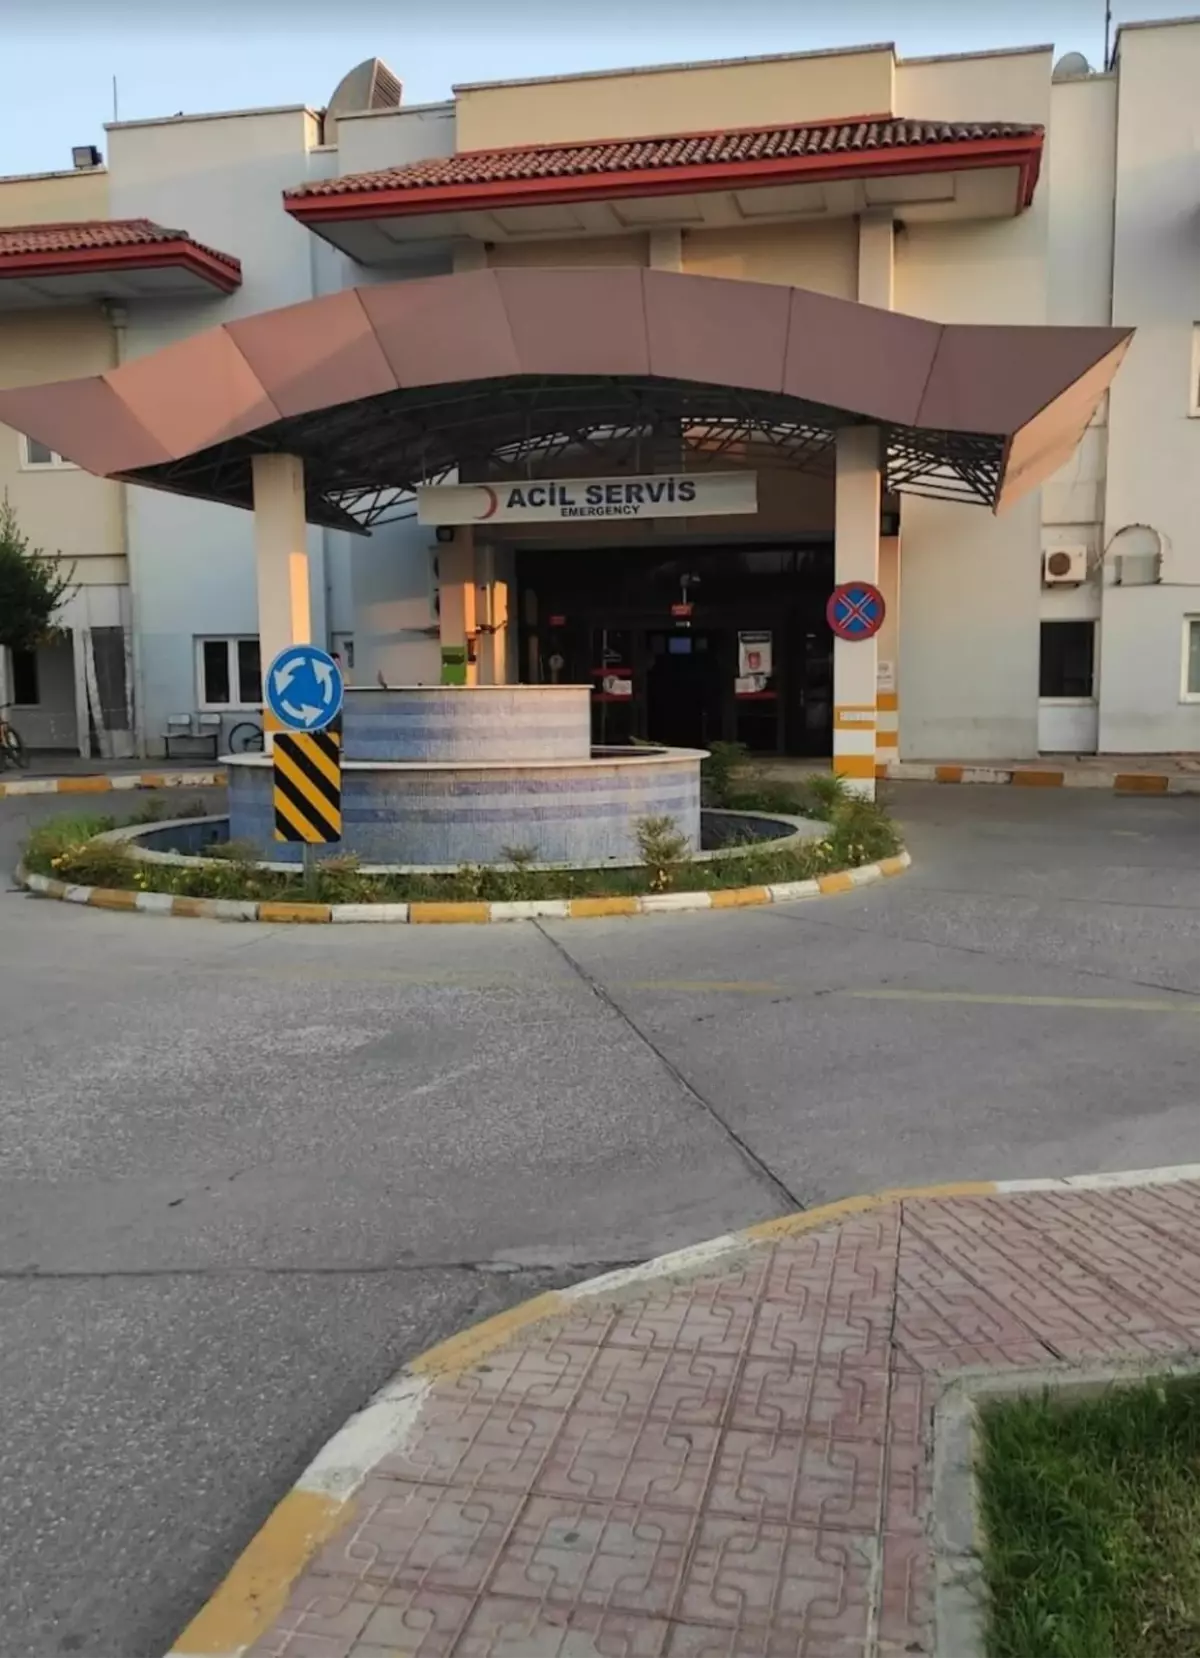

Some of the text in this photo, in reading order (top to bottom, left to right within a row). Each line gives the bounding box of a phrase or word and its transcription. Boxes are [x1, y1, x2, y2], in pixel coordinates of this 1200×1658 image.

[506, 477, 697, 508] ACİL SERVİS
[560, 505, 641, 517] EMERGENCY
